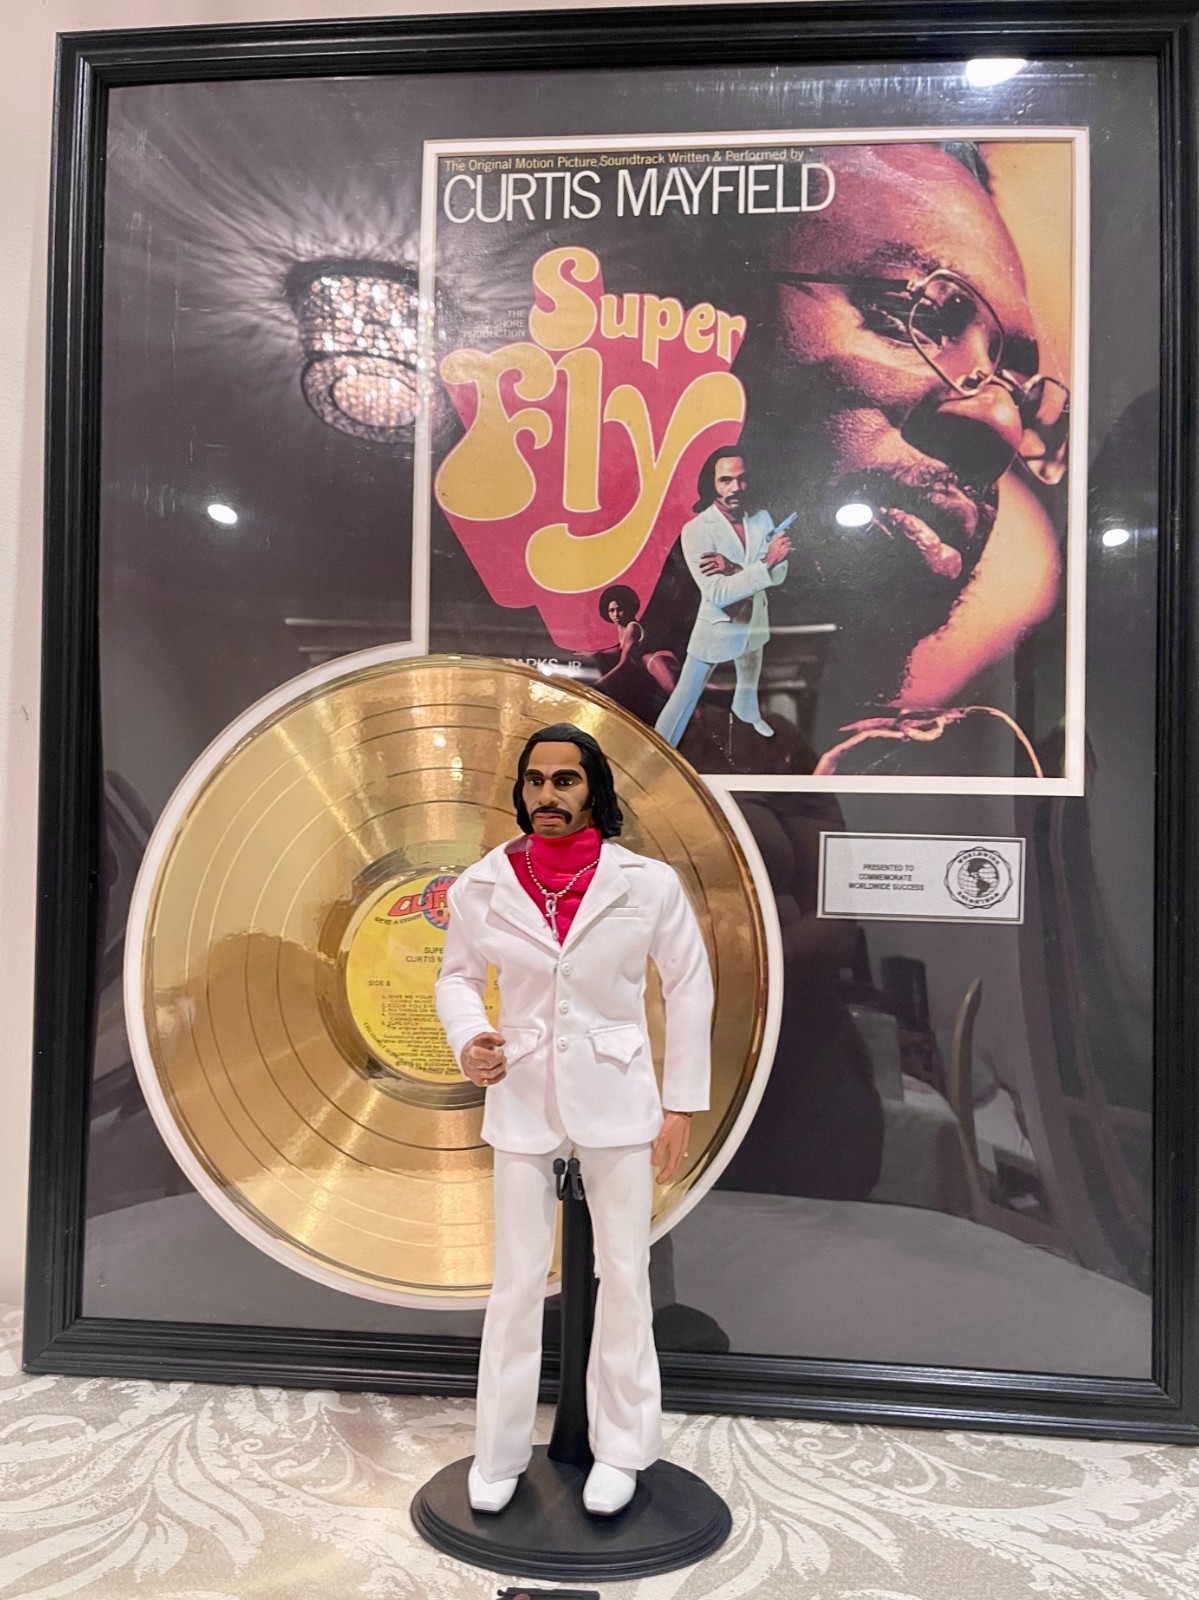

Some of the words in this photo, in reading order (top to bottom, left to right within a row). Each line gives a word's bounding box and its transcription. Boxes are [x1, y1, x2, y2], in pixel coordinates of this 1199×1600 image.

[445, 160, 465, 172] The
[468, 158, 512, 172] Original
[515, 157, 554, 170] Motion
[557, 156, 598, 168] Picture
[599, 153, 665, 167] Soundtrack
[668, 152, 710, 164] Written
[712, 150, 722, 162] &
[725, 149, 787, 162] Performed
[790, 148, 805, 161] by
[443, 170, 601, 224] CURTIS
[617, 162, 836, 218] MAYFIELD
[528, 246, 747, 370] Super
[508, 310, 526, 318] THE
[493, 319, 526, 328] SHORE
[462, 329, 526, 338] PRODUCTION
[434, 342, 747, 594] Fly
[863, 863, 904, 872] PRESENTED
[905, 864, 915, 872] TO
[858, 873, 913, 882] COMMEMORATE
[848, 882, 891, 890] WORLDWIDE
[892, 883, 925, 891] SUCCESS
[424, 946, 444, 954] SUPE
[406, 955, 436, 963] CURTIS
